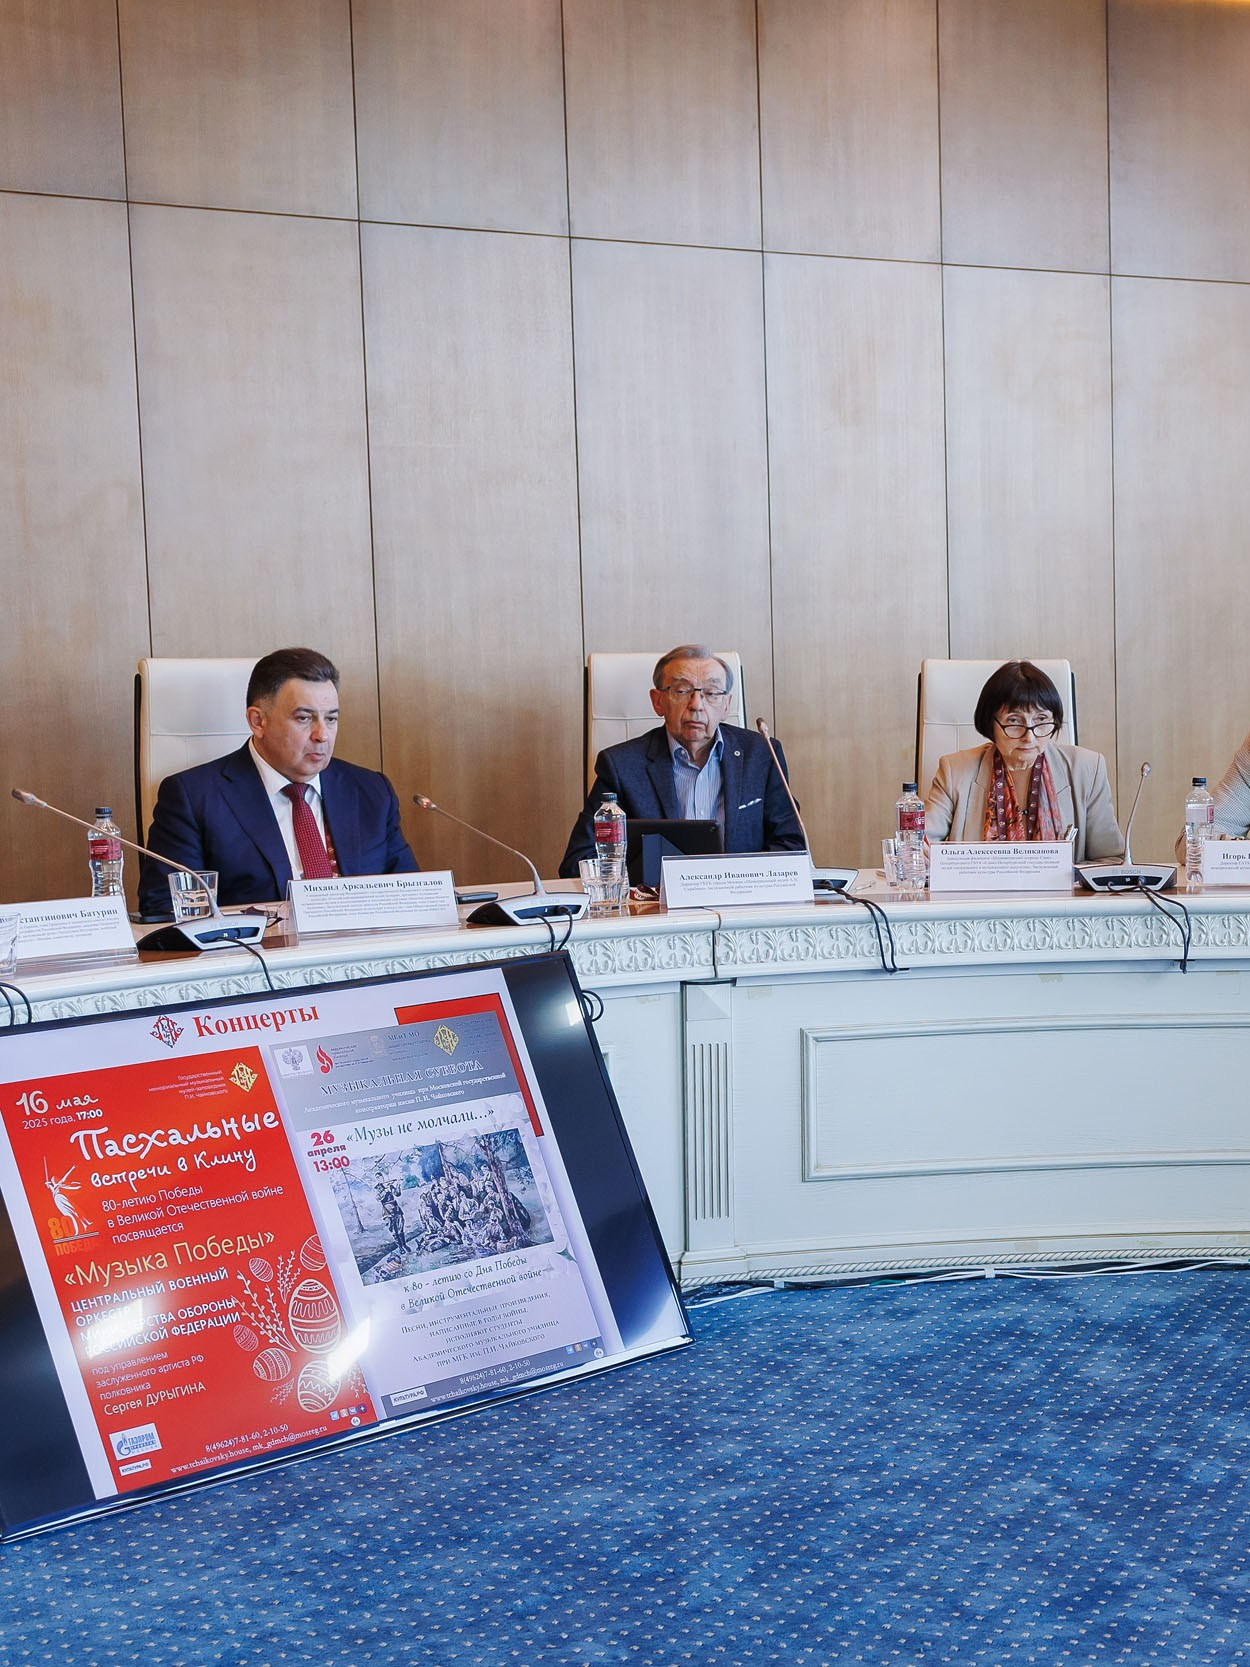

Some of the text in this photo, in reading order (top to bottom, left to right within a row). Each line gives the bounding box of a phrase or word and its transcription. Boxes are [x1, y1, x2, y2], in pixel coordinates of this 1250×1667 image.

[941, 848, 965, 856] Ольга
[1222, 853, 1246, 861] Игорь
[303, 879, 443, 892] Михаил Аркадьевич Брызгалов
[679, 873, 722, 882] Александр
[765, 870, 799, 878] Лазарев
[80, 908, 118, 919] Батурин
[191, 1006, 319, 1037] Концерты
[15, 1089, 48, 1115] 16
[55, 1094, 99, 1110] мая
[21, 1108, 104, 1130] 2025 года, 17:00
[69, 1110, 279, 1161] Пасхальные
[310, 1129, 335, 1146] 26
[193, 1148, 257, 1172] Клину
[307, 1144, 346, 1157] апреля
[177, 1156, 189, 1171] в
[313, 1155, 350, 1172] 13:00
[90, 1165, 172, 1191] встречи
[101, 1185, 204, 1213] 80-летию Победы
[107, 1185, 283, 1228] в Великой Отечественной войне
[111, 1221, 184, 1244] посвящается
[63, 1231, 275, 1287] «Музыка Победы»
[70, 1266, 229, 1313] ЦЕНТРАЛЬНЫЙ ВОЕННЫЙ
[400, 1269, 541, 1310] в Великой Отечественной войне
[177, 1296, 235, 1319] ОБОРОНЫ
[170, 1311, 241, 1336] ФЕДЕРАЦИИ
[102, 1381, 206, 1416] Сергея ДУРЫГИНА
